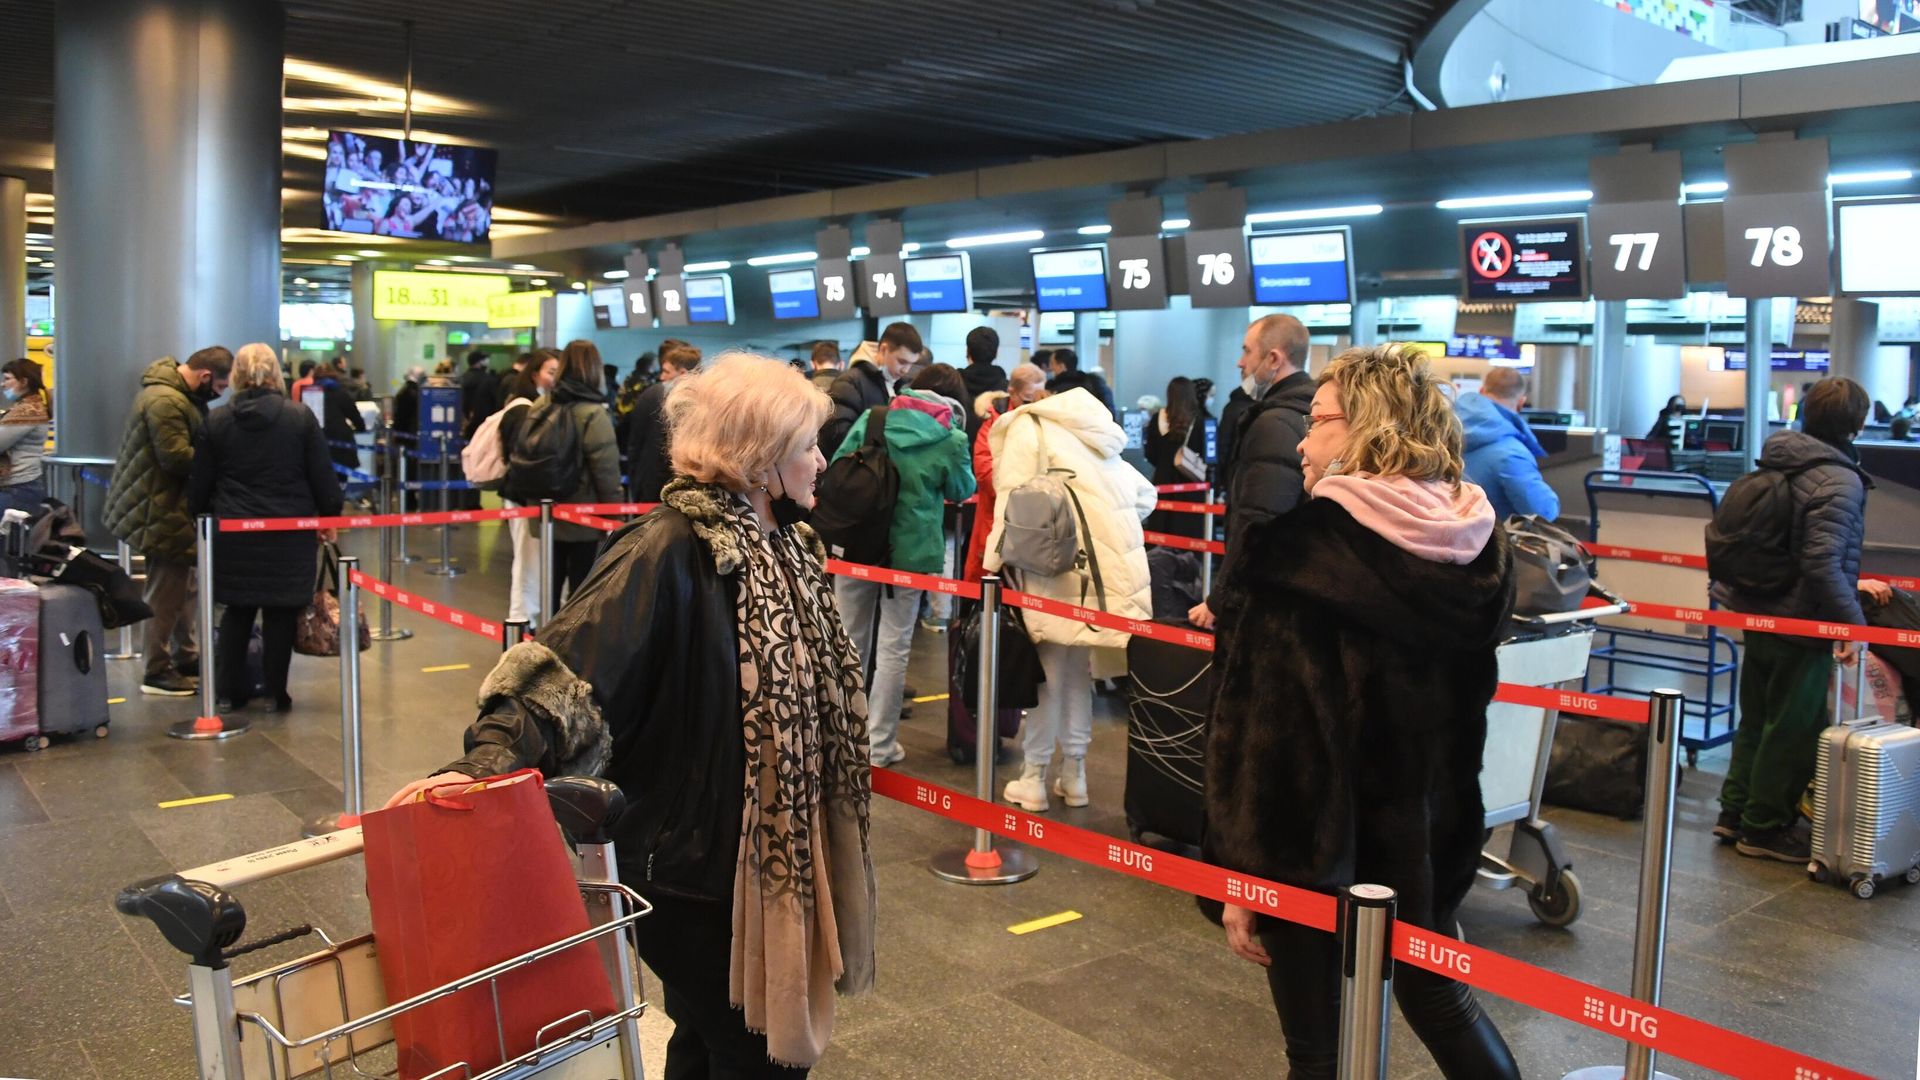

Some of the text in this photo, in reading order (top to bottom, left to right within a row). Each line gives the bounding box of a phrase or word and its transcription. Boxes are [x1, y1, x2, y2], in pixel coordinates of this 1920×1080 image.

[1609, 232, 1660, 272] 77
[1744, 226, 1804, 268] 78
[1118, 258, 1150, 290] 75
[1197, 253, 1235, 286] 76
[872, 272, 896, 299] 74
[1028, 598, 1043, 608] UTG
[1080, 610, 1096, 621] UTG
[1685, 610, 1703, 621] UTG
[1756, 618, 1775, 628] UTG
[1136, 624, 1152, 634] UTG
[1194, 636, 1212, 646] UTG
[1829, 626, 1850, 636] UTG
[1572, 696, 1598, 710] UTG
[1124, 848, 1152, 872] UTG
[1244, 882, 1278, 908] UTG
[1430, 943, 1472, 974] UTG
[1608, 1004, 1658, 1038] UTG
